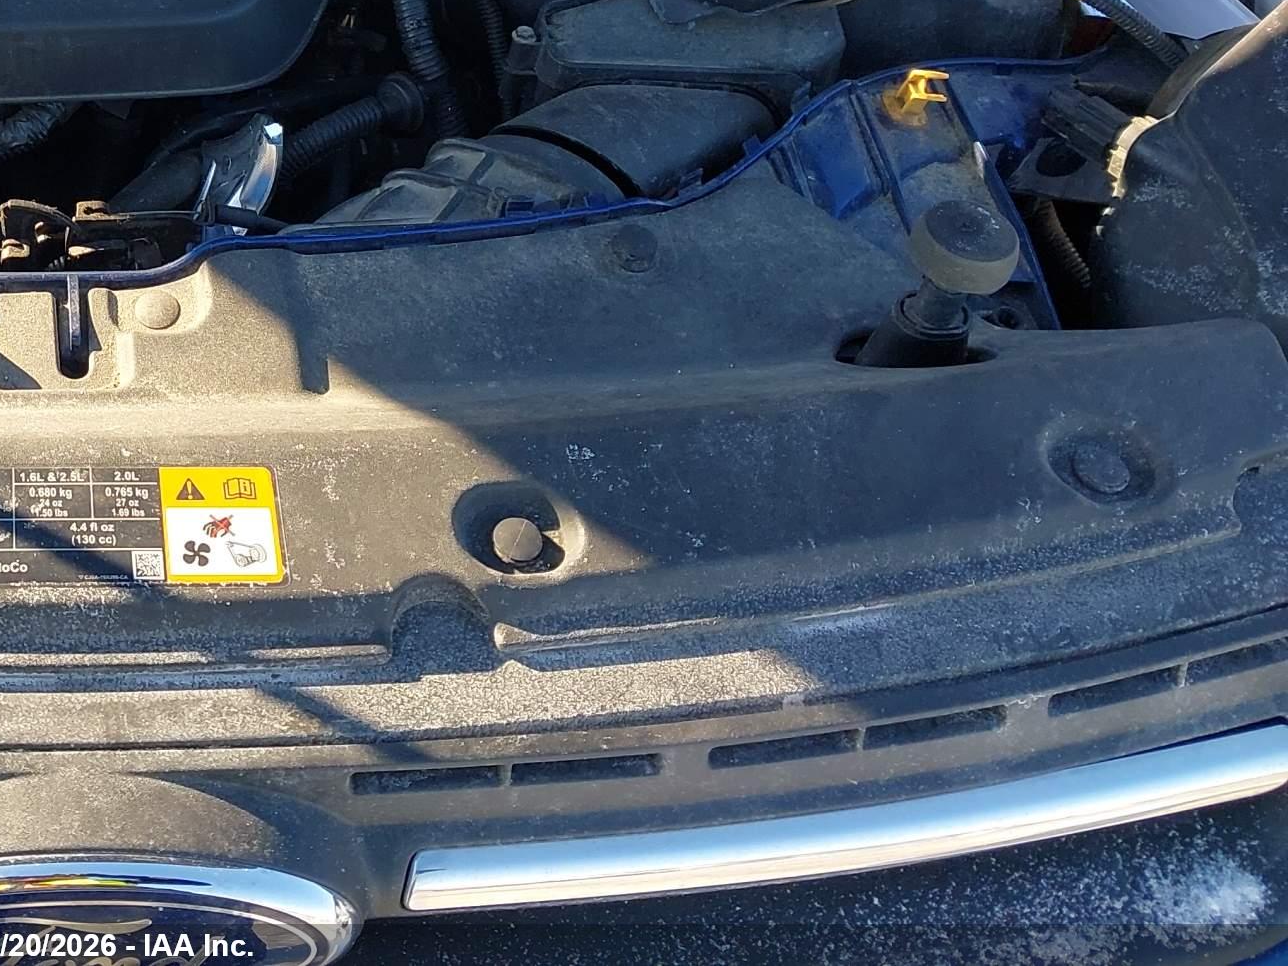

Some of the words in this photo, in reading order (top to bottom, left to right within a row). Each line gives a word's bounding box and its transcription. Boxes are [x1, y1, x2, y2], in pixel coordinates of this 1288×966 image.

[20, 472, 44, 482] 1.6L
[47, 472, 57, 482] &
[59, 472, 85, 482] 2.5L
[114, 471, 140, 481] 2.0L
[29, 487, 57, 498] 0.680
[59, 487, 73, 499] kg
[105, 487, 133, 498] 0.765
[135, 487, 149, 499] kg
[54, 508, 68, 517] lbs
[112, 508, 129, 517] 1.69
[131, 508, 145, 517] lbs
[70, 523, 87, 532] 4.4
[90, 522, 98, 532] fl
[100, 524, 115, 532] oz
[71, 534, 95, 546] (130
[98, 534, 117, 546] cc)
